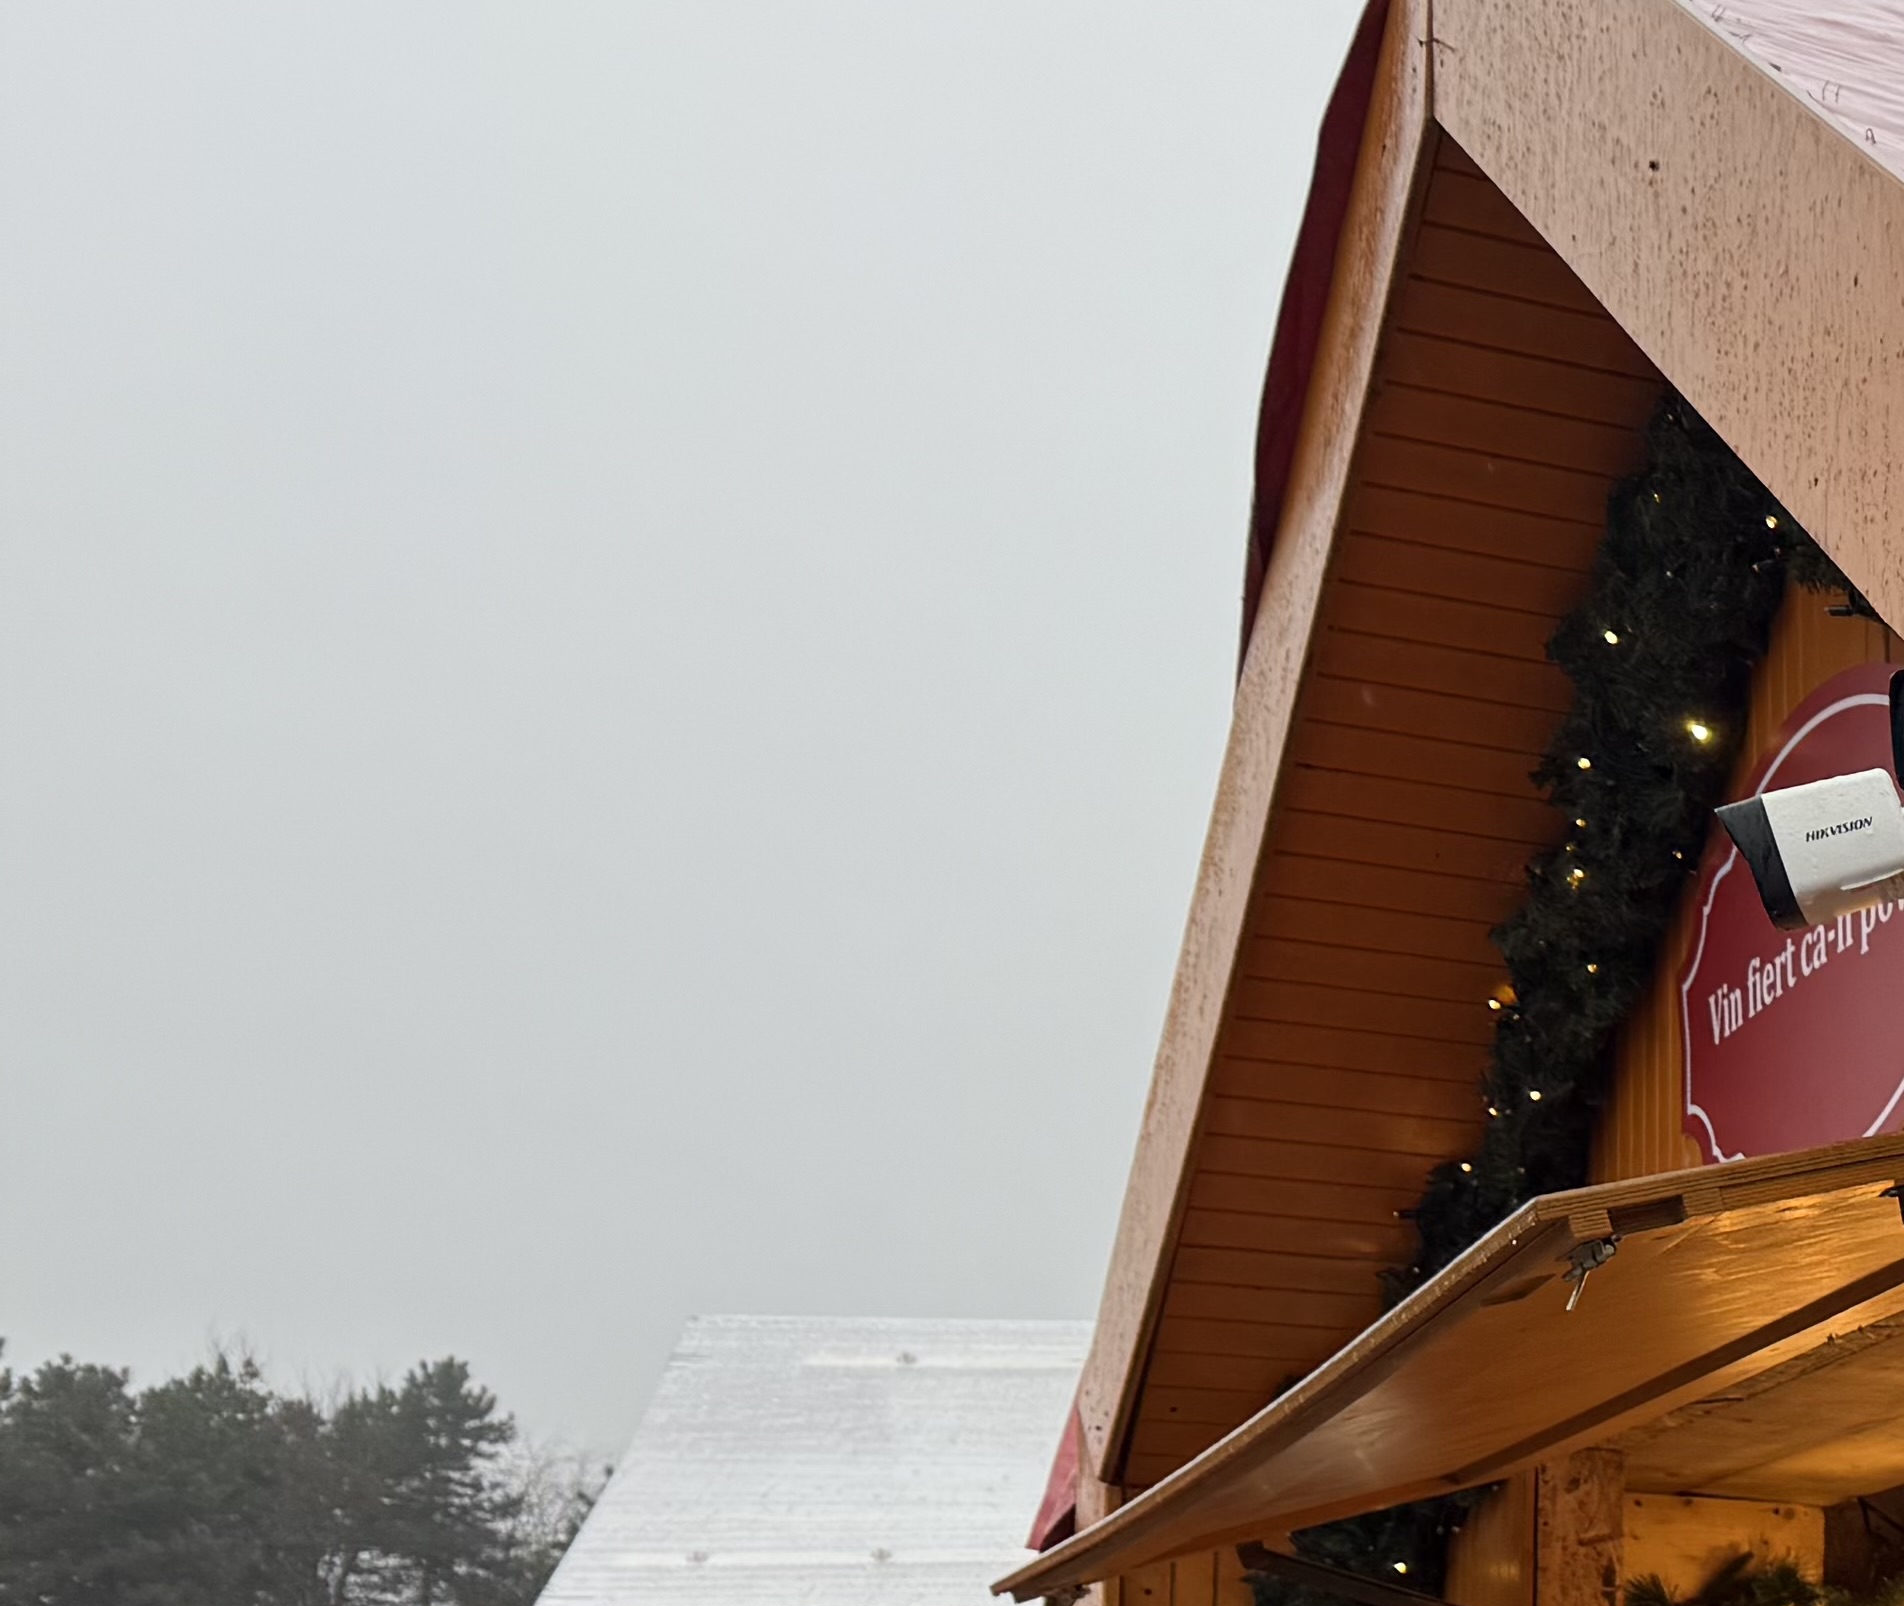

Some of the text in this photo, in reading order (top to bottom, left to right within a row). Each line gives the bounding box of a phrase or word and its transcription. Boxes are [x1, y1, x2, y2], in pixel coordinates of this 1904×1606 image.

[1805, 816, 1873, 843] HIKVISION
[1708, 983, 1744, 1046] Vin
[1747, 937, 1798, 1019] fiert
